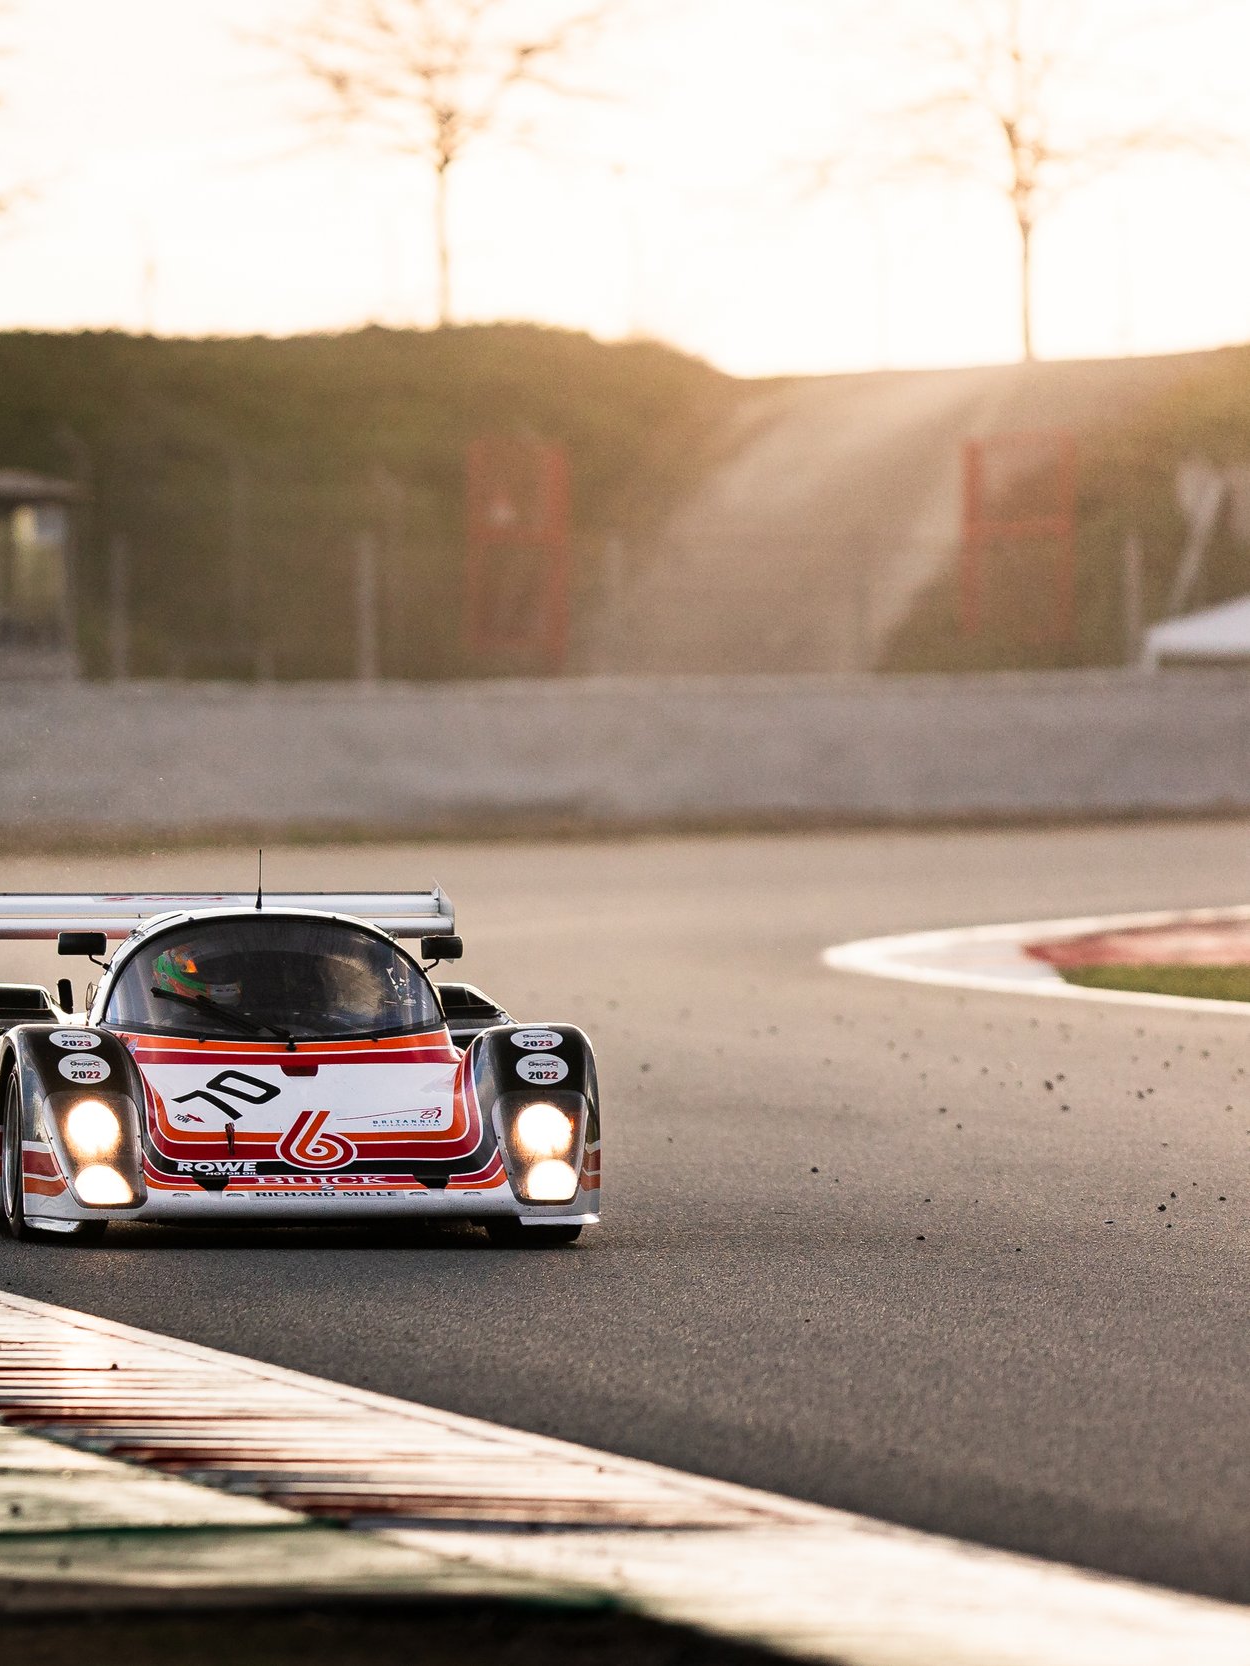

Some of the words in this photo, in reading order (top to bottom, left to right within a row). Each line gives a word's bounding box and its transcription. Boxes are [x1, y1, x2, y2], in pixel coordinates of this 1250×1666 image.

[70, 1070, 101, 1079] 2022
[527, 1071, 558, 1079] 2022
[170, 1070, 281, 1121] 70
[174, 1113, 192, 1123] TOW
[177, 1161, 257, 1172] ROWE
[254, 1175, 389, 1184] BUICK
